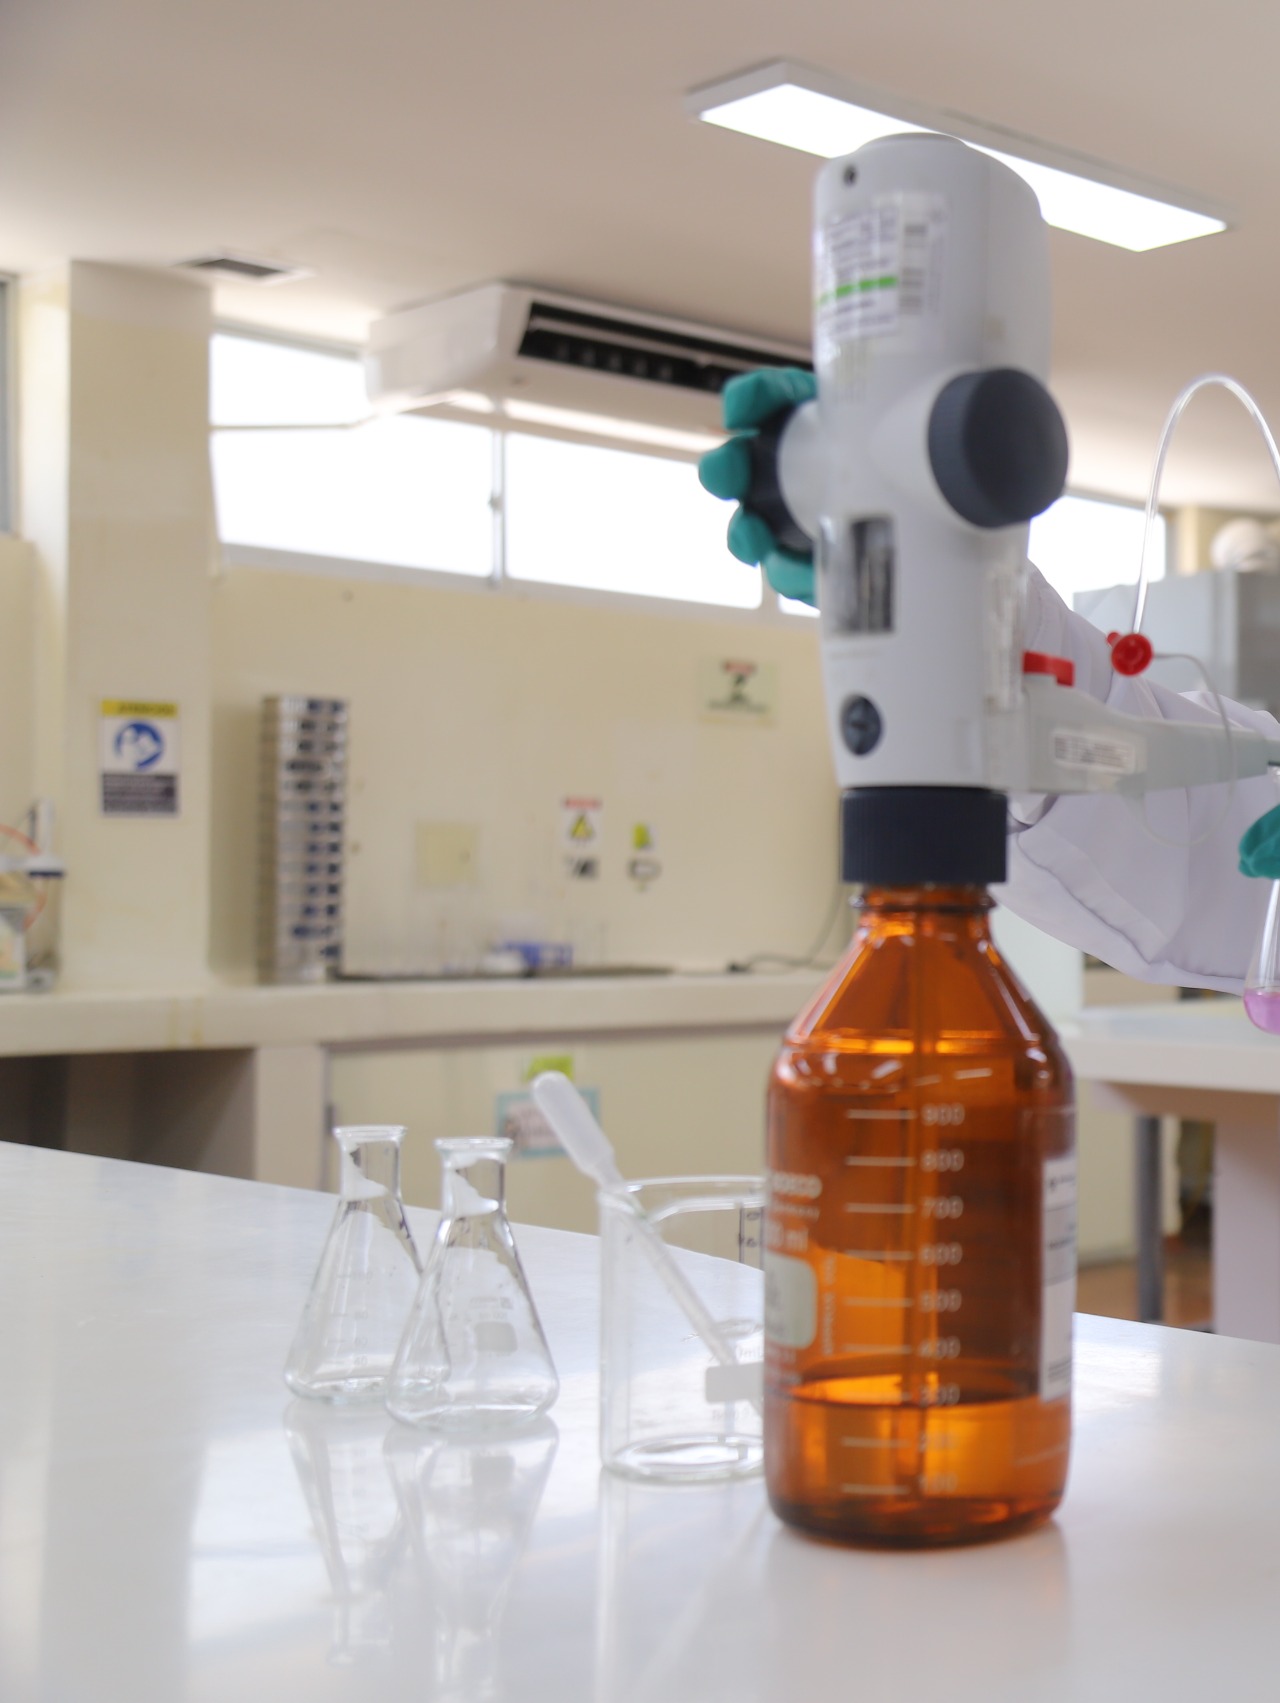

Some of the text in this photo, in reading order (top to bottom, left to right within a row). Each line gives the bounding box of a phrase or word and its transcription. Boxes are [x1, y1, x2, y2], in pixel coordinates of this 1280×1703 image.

[921, 1103, 965, 1126] 900
[920, 1149, 964, 1173] 800
[919, 1196, 964, 1219] 700
[919, 1242, 963, 1265] 600
[918, 1289, 961, 1312] 500
[918, 1336, 960, 1359] 400
[918, 1382, 959, 1406] 300
[918, 1431, 957, 1453] 200
[918, 1472, 957, 1495] 100
